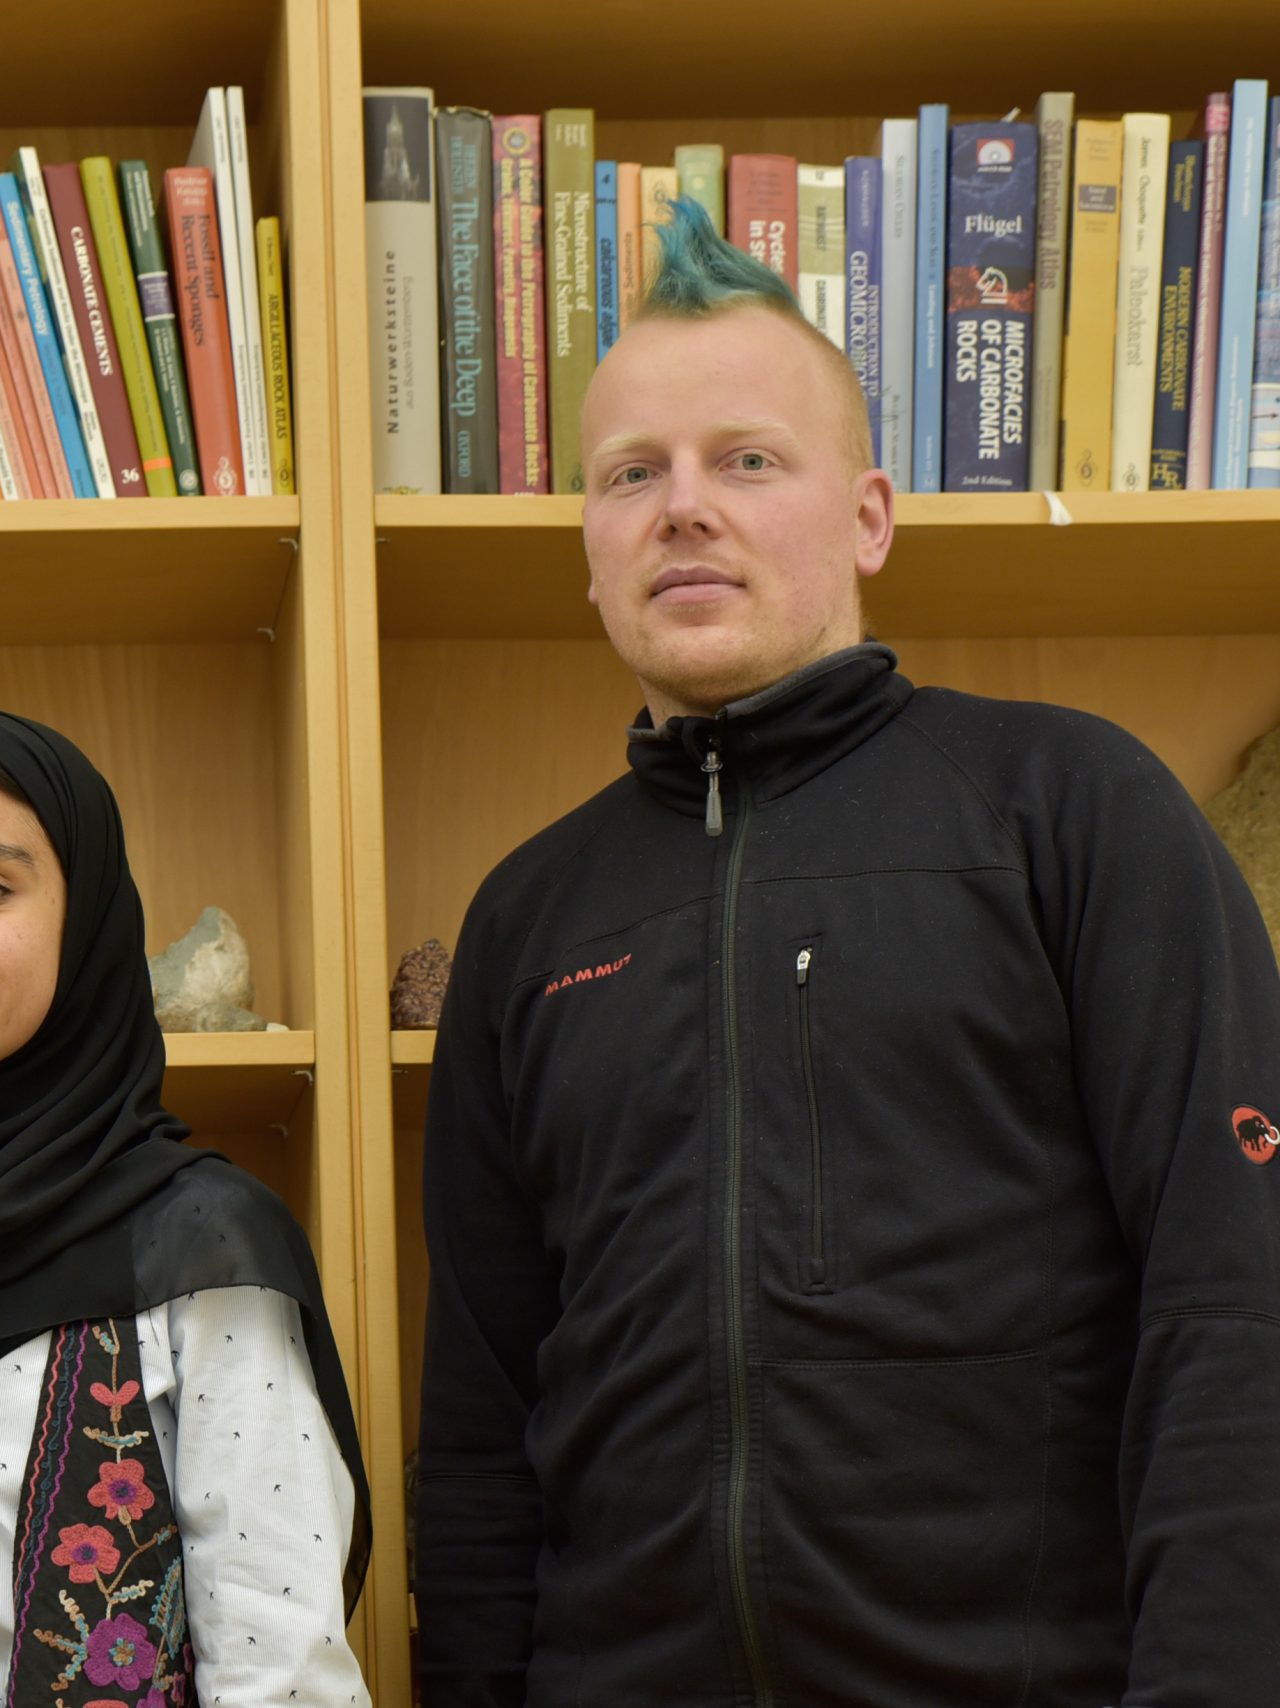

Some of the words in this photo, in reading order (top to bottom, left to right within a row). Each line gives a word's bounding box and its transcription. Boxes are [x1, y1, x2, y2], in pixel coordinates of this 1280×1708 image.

[1043, 118, 1063, 157] SEM
[1139, 136, 1151, 168] James
[518, 168, 534, 203] Color
[1038, 158, 1063, 243] Petrology
[1135, 173, 1150, 225] Choquette
[196, 213, 217, 263] Fossil
[451, 196, 479, 239] The
[518, 204, 535, 242] Guide
[553, 191, 571, 280] Fine-Grained
[749, 220, 766, 238] in
[964, 214, 1023, 238] Flügel
[179, 214, 200, 272] Recent
[519, 242, 535, 257] to
[572, 190, 590, 294] Microstructure
[5, 200, 36, 277] Sedimentary
[23, 276, 52, 338] Petrology
[202, 263, 221, 300] and
[452, 242, 480, 293] Face
[520, 257, 536, 280] the
[1038, 245, 1059, 290] Atlas
[56, 286, 67, 301] and
[68, 224, 99, 310] CARBONATE
[86, 308, 113, 377] CEMENTS
[182, 274, 208, 347] Sponges
[453, 293, 480, 319] of
[574, 295, 592, 313] of
[1125, 264, 1147, 367] Paleokarst
[1175, 266, 1193, 327] MODERN
[266, 293, 283, 374] ARGILLACEOUS
[383, 249, 398, 435] Naturwerksteine
[401, 274, 416, 387] Baden-Württemberg
[453, 316, 480, 355] the
[519, 281, 537, 360] Petrography
[554, 283, 571, 357] Sediments
[866, 283, 880, 378] INTRODUCTION
[980, 318, 1001, 346] OF
[1157, 285, 1180, 392] ENVIRONMENTS
[522, 360, 538, 376] of
[955, 319, 978, 383] ROCKS
[1170, 328, 1189, 412] CARBONATE
[272, 374, 285, 405] ROCK
[406, 389, 414, 410] aus
[450, 357, 482, 417] Deep
[867, 378, 879, 397] TO
[976, 346, 1002, 460] CARBONATE
[1001, 319, 1025, 444] MICROFACIES
[274, 405, 288, 440] ATLAS
[523, 375, 539, 442] Carbonate
[121, 467, 140, 484] 36
[457, 430, 469, 477] OXFORD
[524, 442, 540, 487] Rocks:
[961, 474, 979, 486] 2nd
[980, 475, 1013, 486] Edition
[544, 953, 632, 997] MAMMUT
